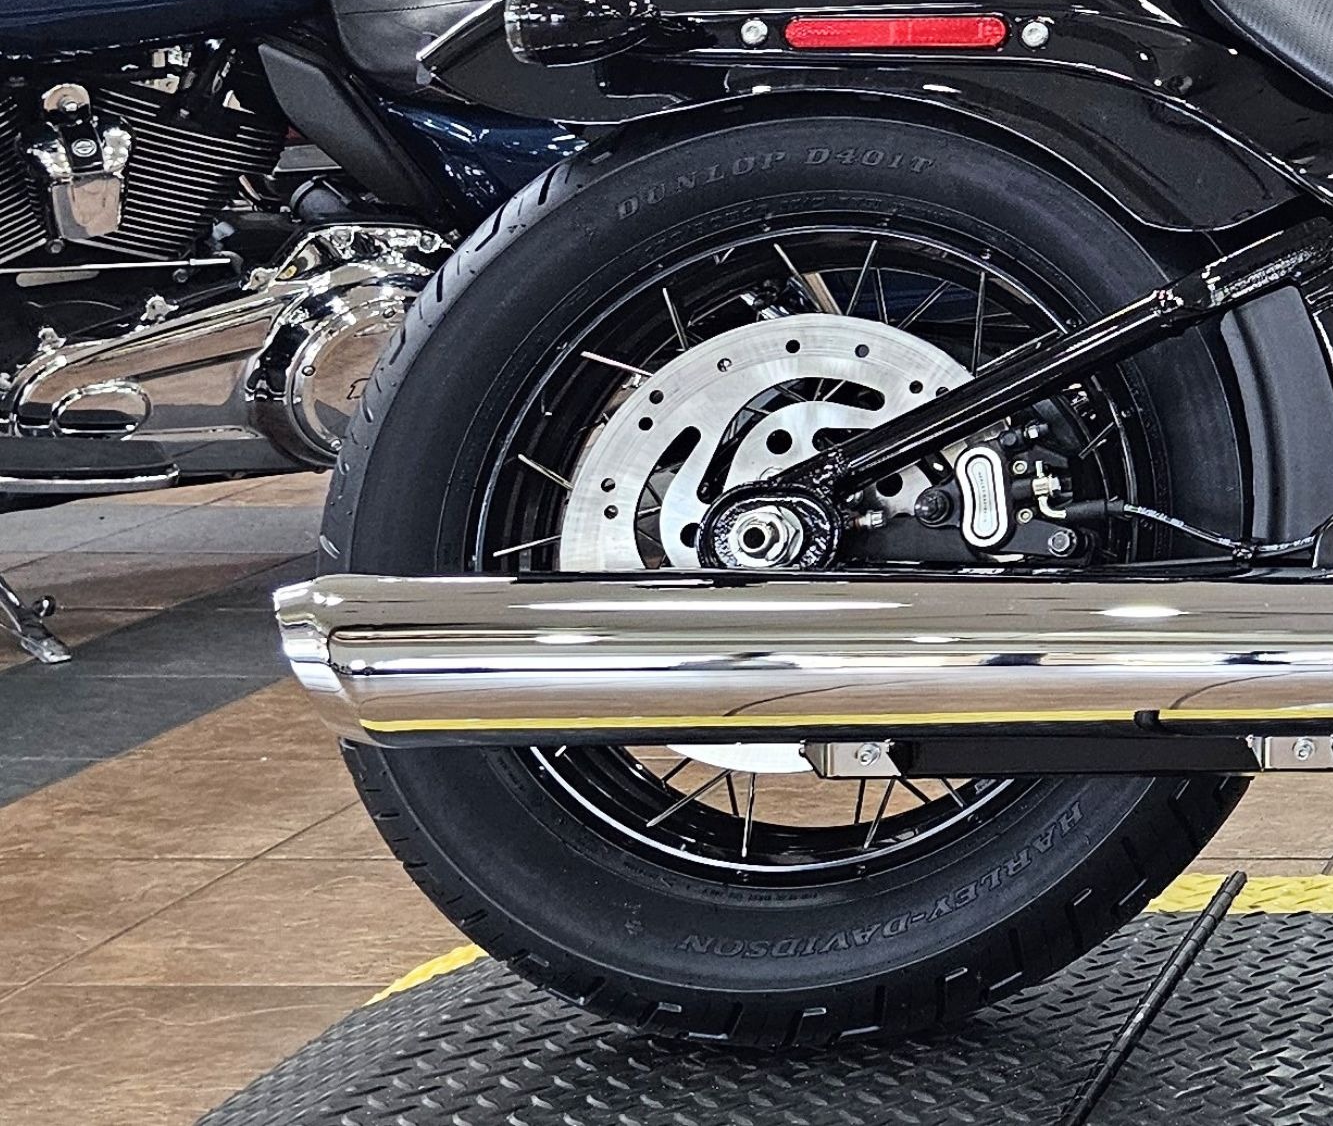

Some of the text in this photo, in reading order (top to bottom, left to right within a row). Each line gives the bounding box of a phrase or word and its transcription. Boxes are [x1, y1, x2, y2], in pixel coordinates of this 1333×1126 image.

[617, 147, 936, 220] DUNLOP D401T
[677, 800, 1085, 960] HARLEY-DAVIDSON
